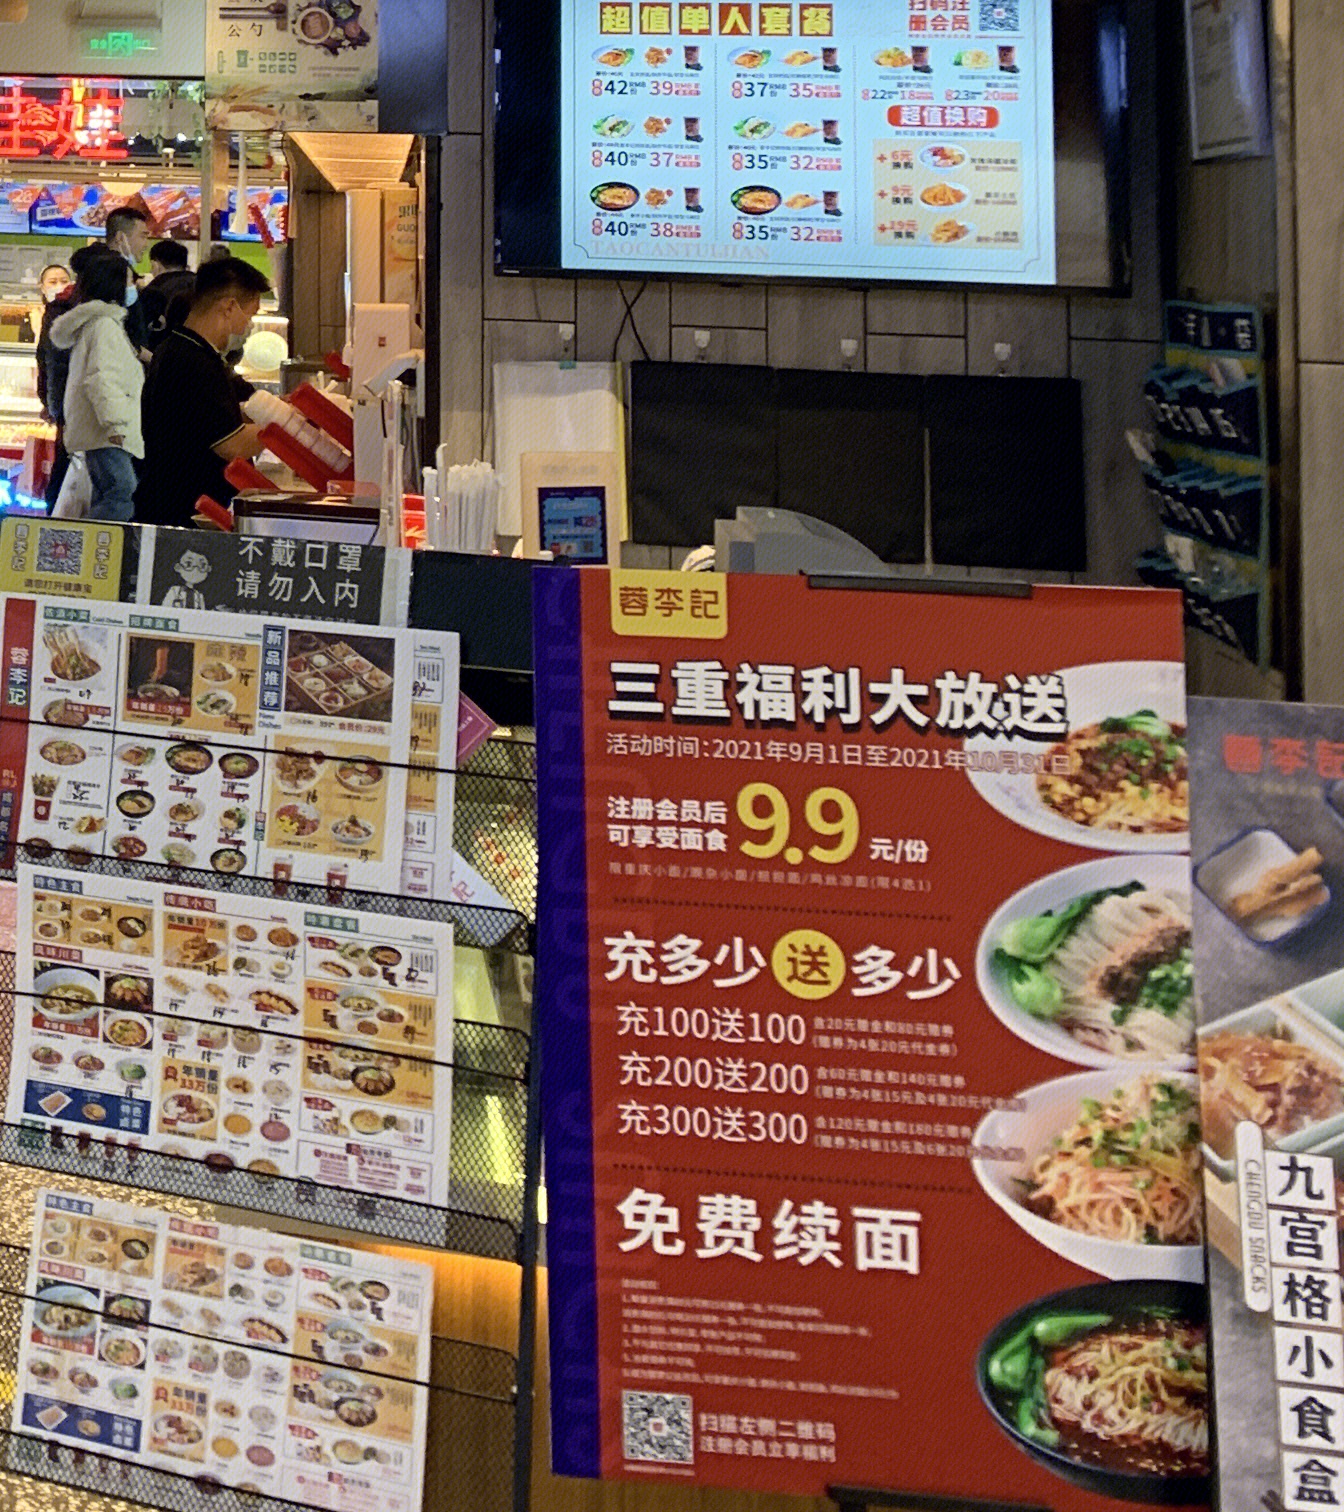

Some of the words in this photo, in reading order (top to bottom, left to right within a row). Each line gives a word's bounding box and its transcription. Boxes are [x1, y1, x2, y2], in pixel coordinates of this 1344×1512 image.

[227, 22, 263, 38] 公勺
[601, 4, 832, 35] 超值单人套餐
[604, 80, 628, 96] 42
[649, 81, 673, 96] 39
[744, 82, 768, 97] 37
[789, 82, 813, 98] 35
[605, 151, 628, 166] 40
[649, 152, 673, 167] 37
[745, 154, 768, 169] 35
[790, 155, 815, 170] 32
[605, 220, 628, 236] 40
[650, 222, 674, 237] 38
[745, 224, 769, 239] 35
[790, 226, 815, 241] 32
[238, 536, 362, 573] 不戴口罩
[236, 569, 360, 609] 请勿入内
[619, 585, 720, 619] 蓉李記
[263, 629, 283, 707] 新品推荐
[608, 660, 1069, 738] 三重福利大放送
[607, 796, 728, 824] 注册会员后
[736, 782, 860, 865] 9.9
[607, 824, 728, 852] 可享受面食
[870, 837, 929, 863] 元/份
[616, 1001, 807, 1045] 充100送100
[618, 1050, 810, 1095] 充200送200
[617, 1099, 809, 1144] 充300送300
[1245, 1159, 1264, 1231] CHENGDU
[616, 1187, 922, 1275] 免费续面
[1248, 1236, 1268, 1294] SNACKS
[1278, 1155, 1340, 1506] 九宫格小食盒
